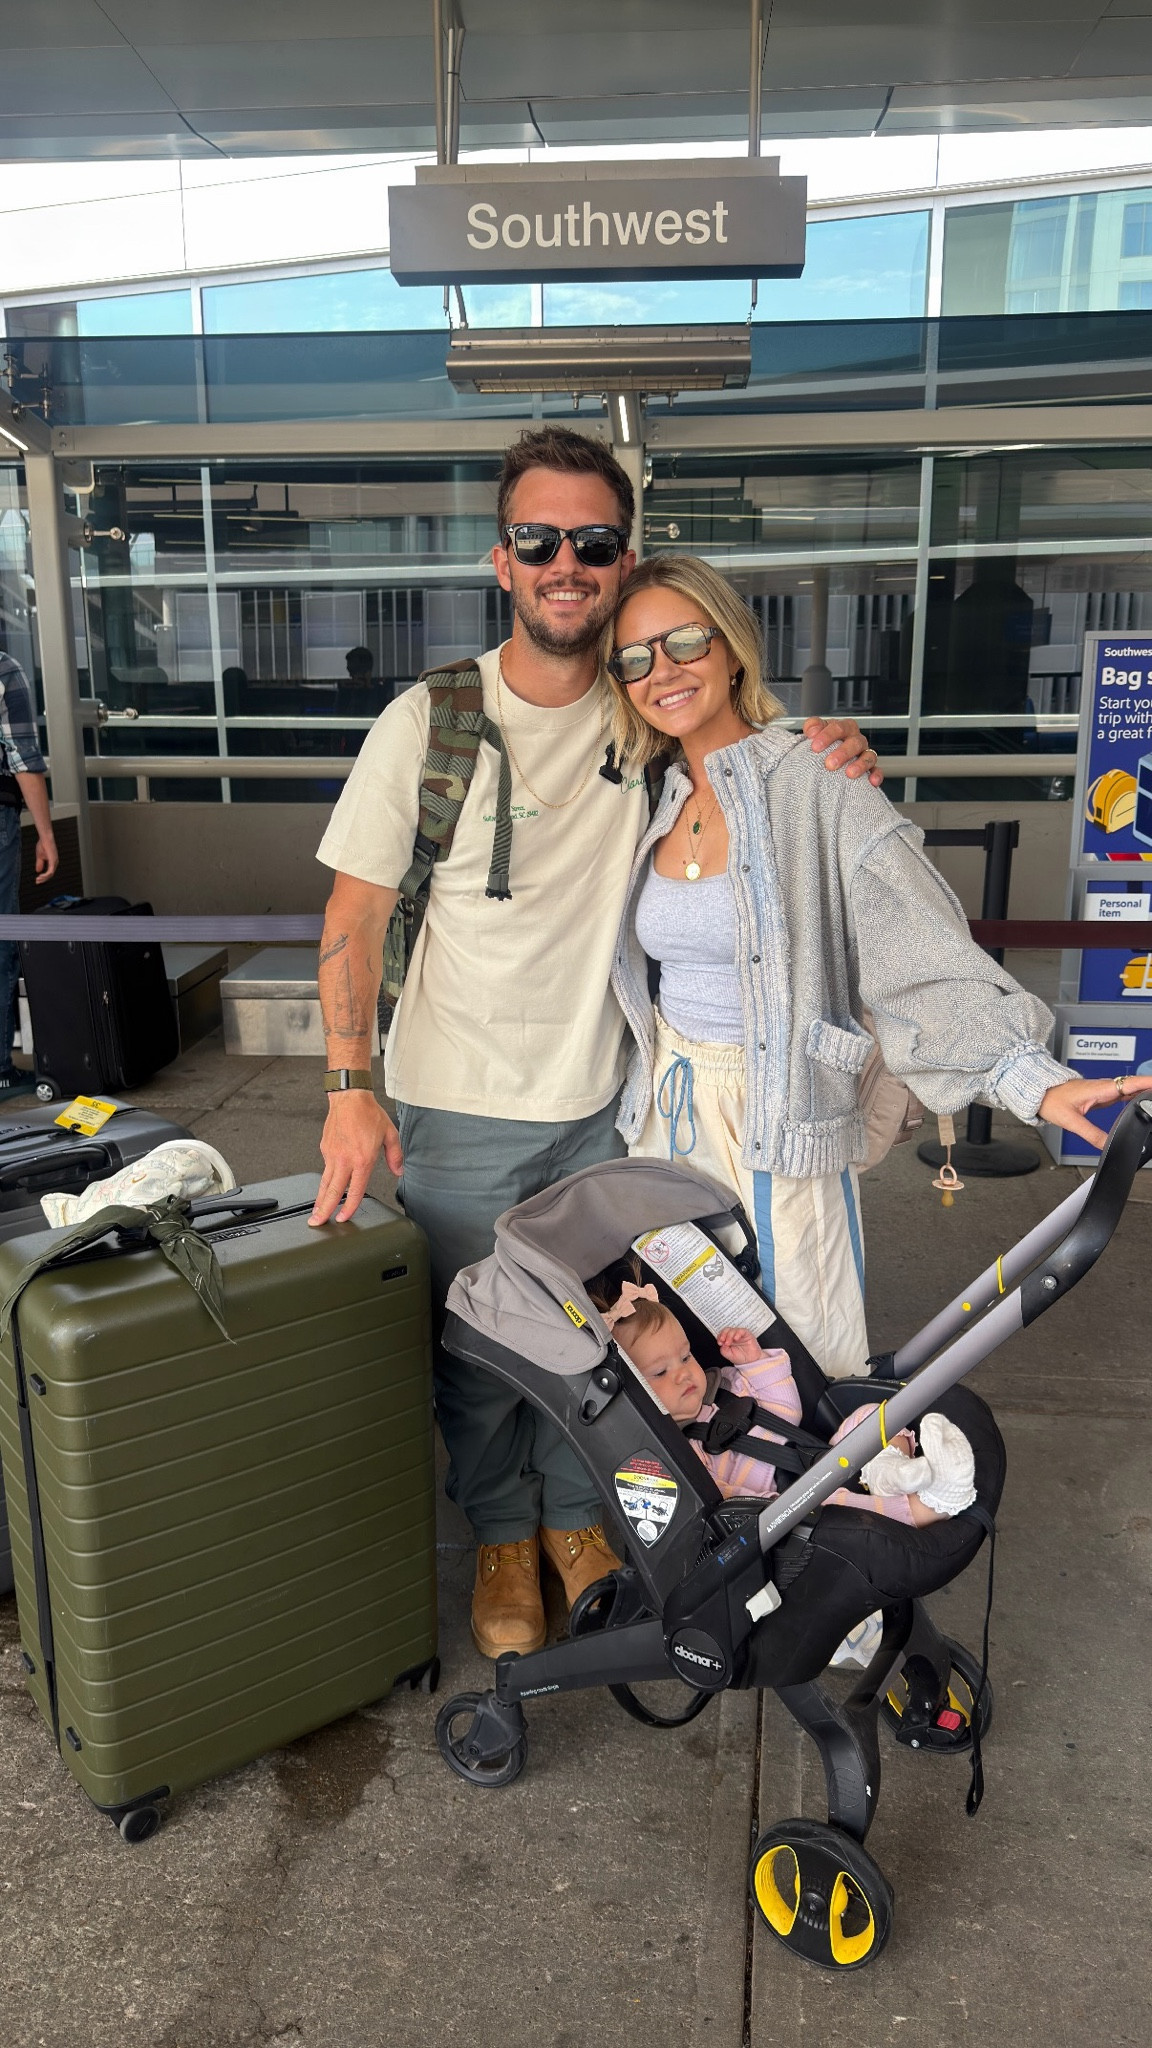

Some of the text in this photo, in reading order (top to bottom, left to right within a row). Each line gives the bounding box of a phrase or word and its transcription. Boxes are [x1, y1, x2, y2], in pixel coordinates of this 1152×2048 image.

[467, 201, 729, 249] Southwest
[1101, 667, 1142, 690] Bag
[1099, 696, 1152, 712] Start yo
[1098, 712, 1122, 727] trip
[1097, 729, 1105, 739] a
[1108, 728, 1144, 742] great
[1099, 899, 1142, 908] Personal
[1098, 909, 1121, 917] item
[1076, 1039, 1118, 1051] Carryon
